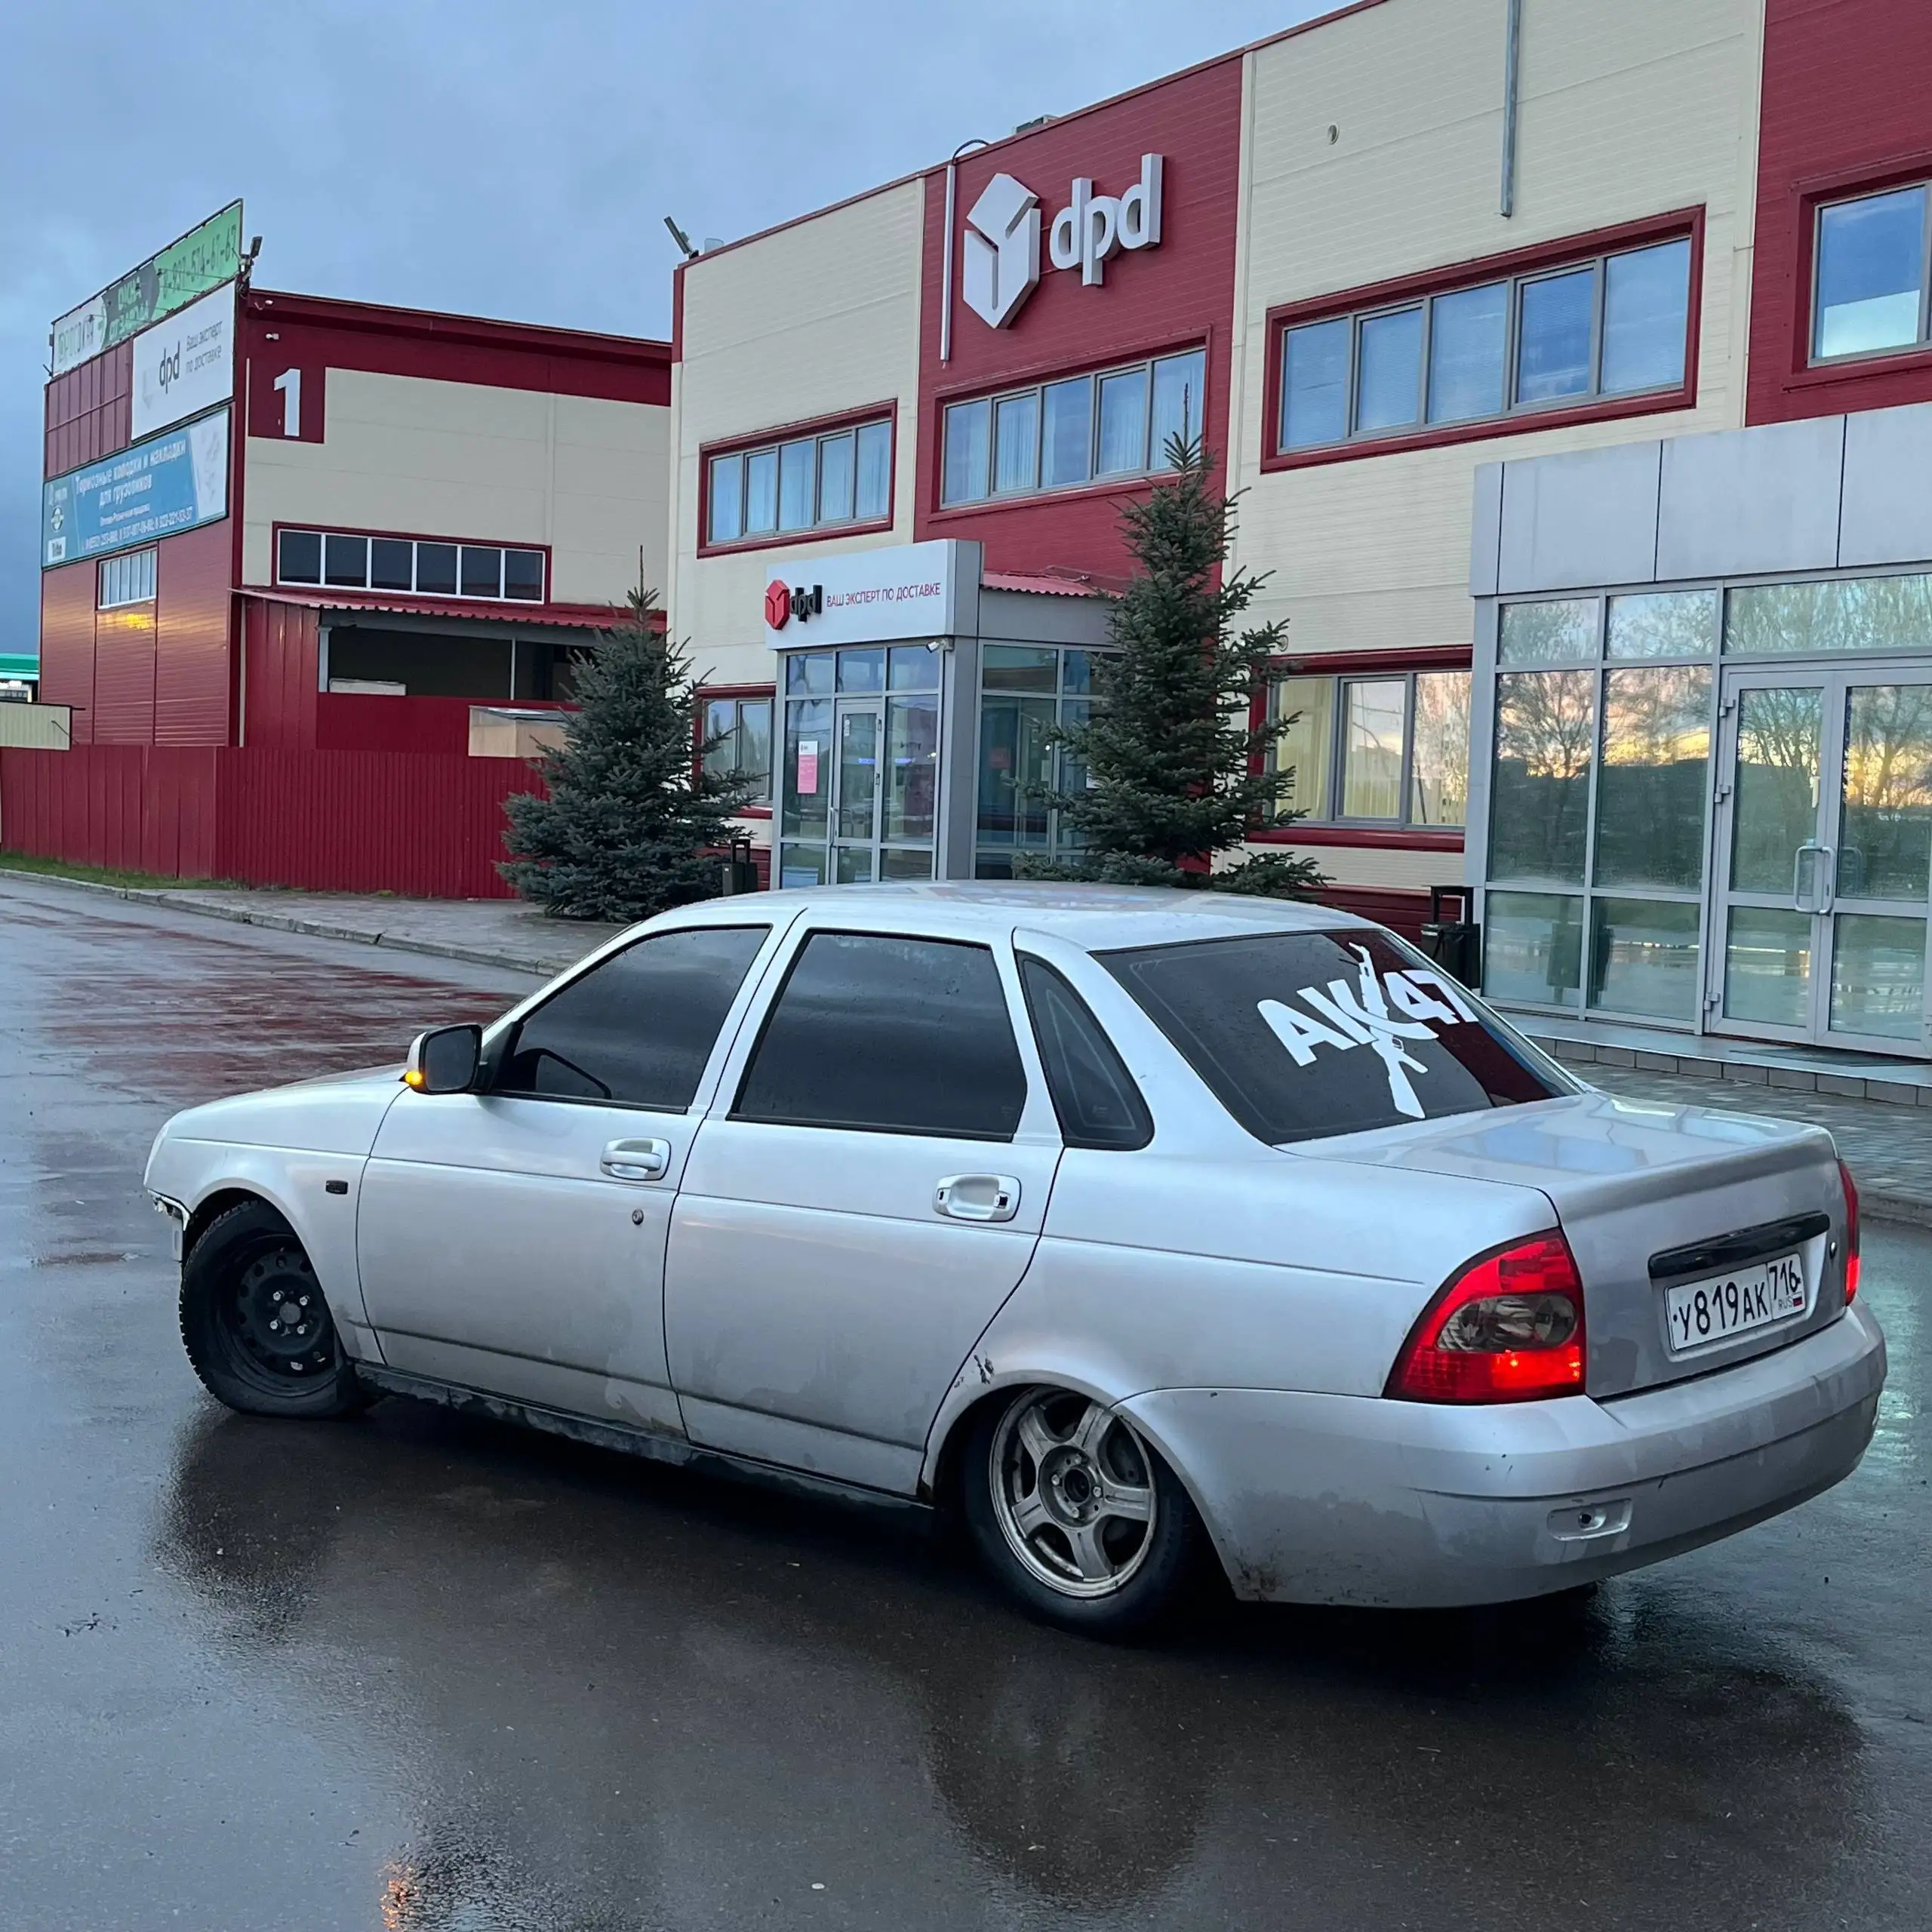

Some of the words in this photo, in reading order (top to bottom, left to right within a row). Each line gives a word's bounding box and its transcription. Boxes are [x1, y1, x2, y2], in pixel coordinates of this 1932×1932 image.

[1050, 153, 1163, 286] dpd
[159, 340, 180, 395] dpd
[274, 368, 301, 437] 1
[790, 584, 823, 623] dpd
[826, 594, 844, 608] ВАШ
[845, 589, 881, 605] ЭКСПЕРТ
[881, 588, 894, 601] ПО
[896, 582, 941, 601] ДОСТАВКЕ
[1769, 1260, 1799, 1300] 716
[1778, 1296, 1793, 1310] RUS
